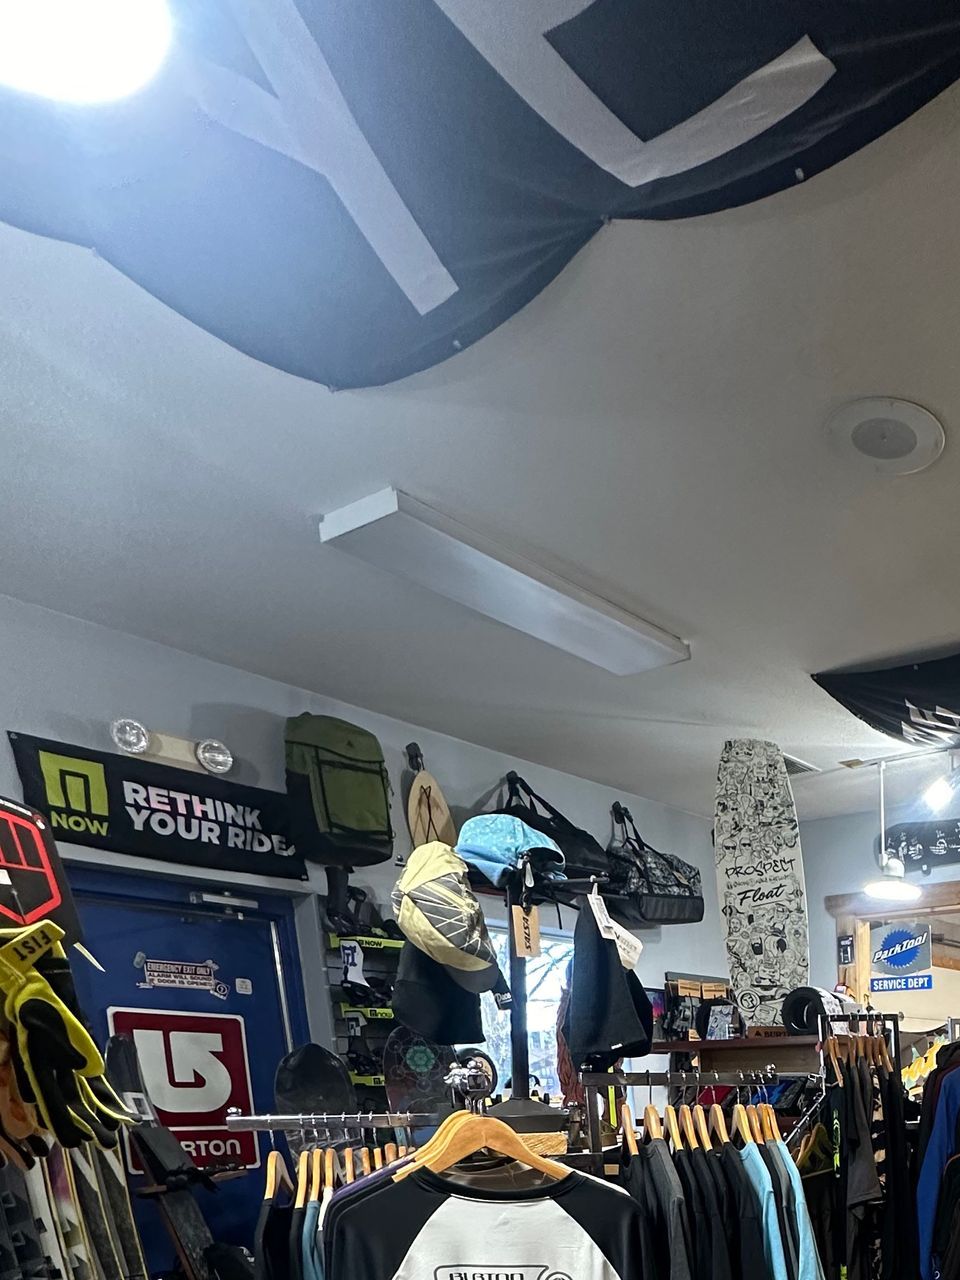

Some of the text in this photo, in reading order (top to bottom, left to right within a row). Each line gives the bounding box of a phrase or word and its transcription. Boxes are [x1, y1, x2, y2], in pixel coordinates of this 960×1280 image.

[122, 781, 262, 830] RETHINK
[51, 811, 109, 837] NOW
[125, 806, 220, 846] YOUR
[725, 858, 796, 878] PROSPECT
[737, 884, 787, 906] Float
[13, 930, 51, 961] FIST
[524, 916, 532, 952] SALSA
[183, 966, 196, 974] EXIT
[873, 975, 929, 990] SERVICE DEPT
[184, 1140, 241, 1157] RTON
